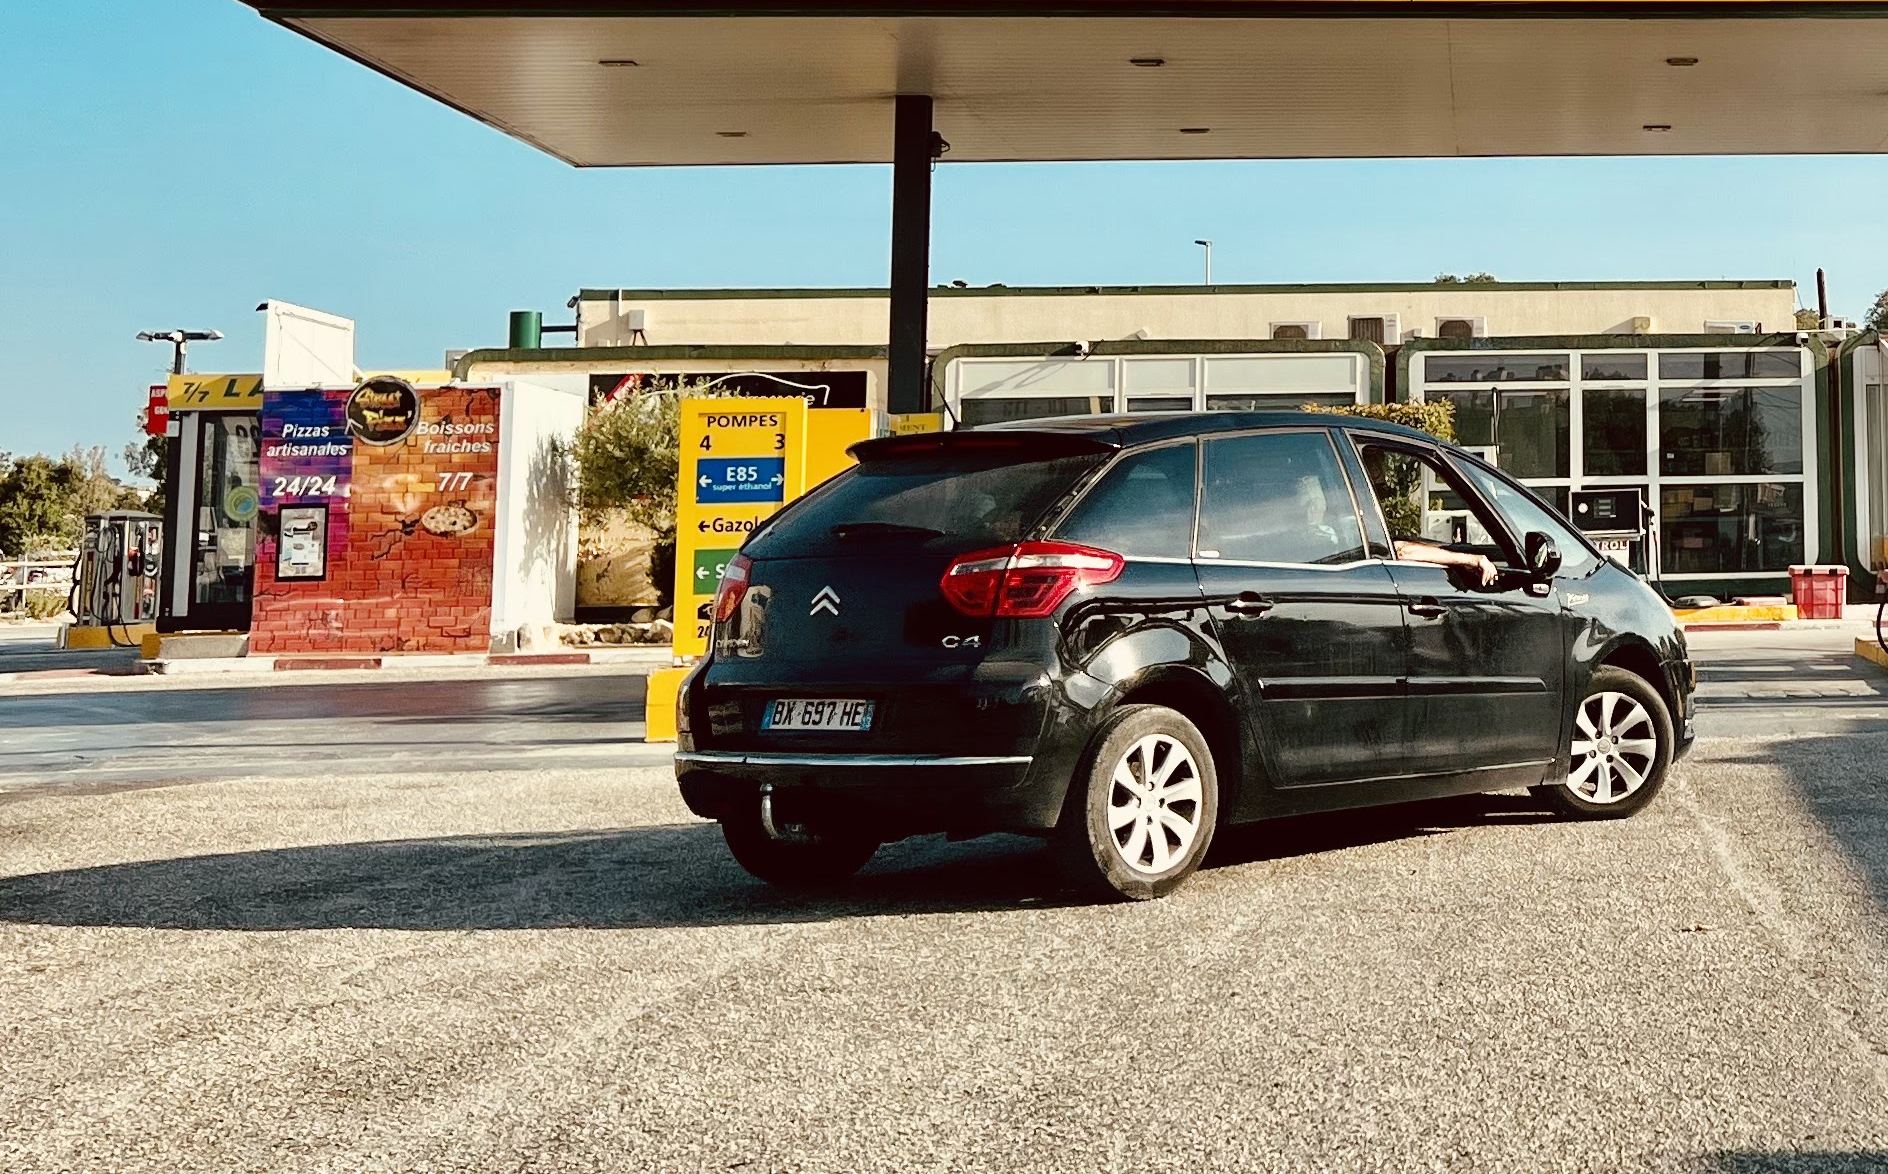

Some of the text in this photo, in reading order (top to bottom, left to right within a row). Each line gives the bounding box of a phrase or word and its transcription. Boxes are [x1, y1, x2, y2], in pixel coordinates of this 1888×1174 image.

[184, 382, 209, 403] 7/7
[416, 420, 494, 436] Boissons
[707, 414, 778, 427] POMPES
[282, 424, 330, 438] Pizzas
[266, 441, 348, 458] artisanales
[699, 433, 785, 451] 4 3
[438, 472, 474, 491] 7/7
[726, 466, 758, 482] E85
[272, 476, 336, 497] 24/24
[712, 483, 736, 492] super
[713, 516, 764, 533] Gazol
[942, 635, 981, 648] C4
